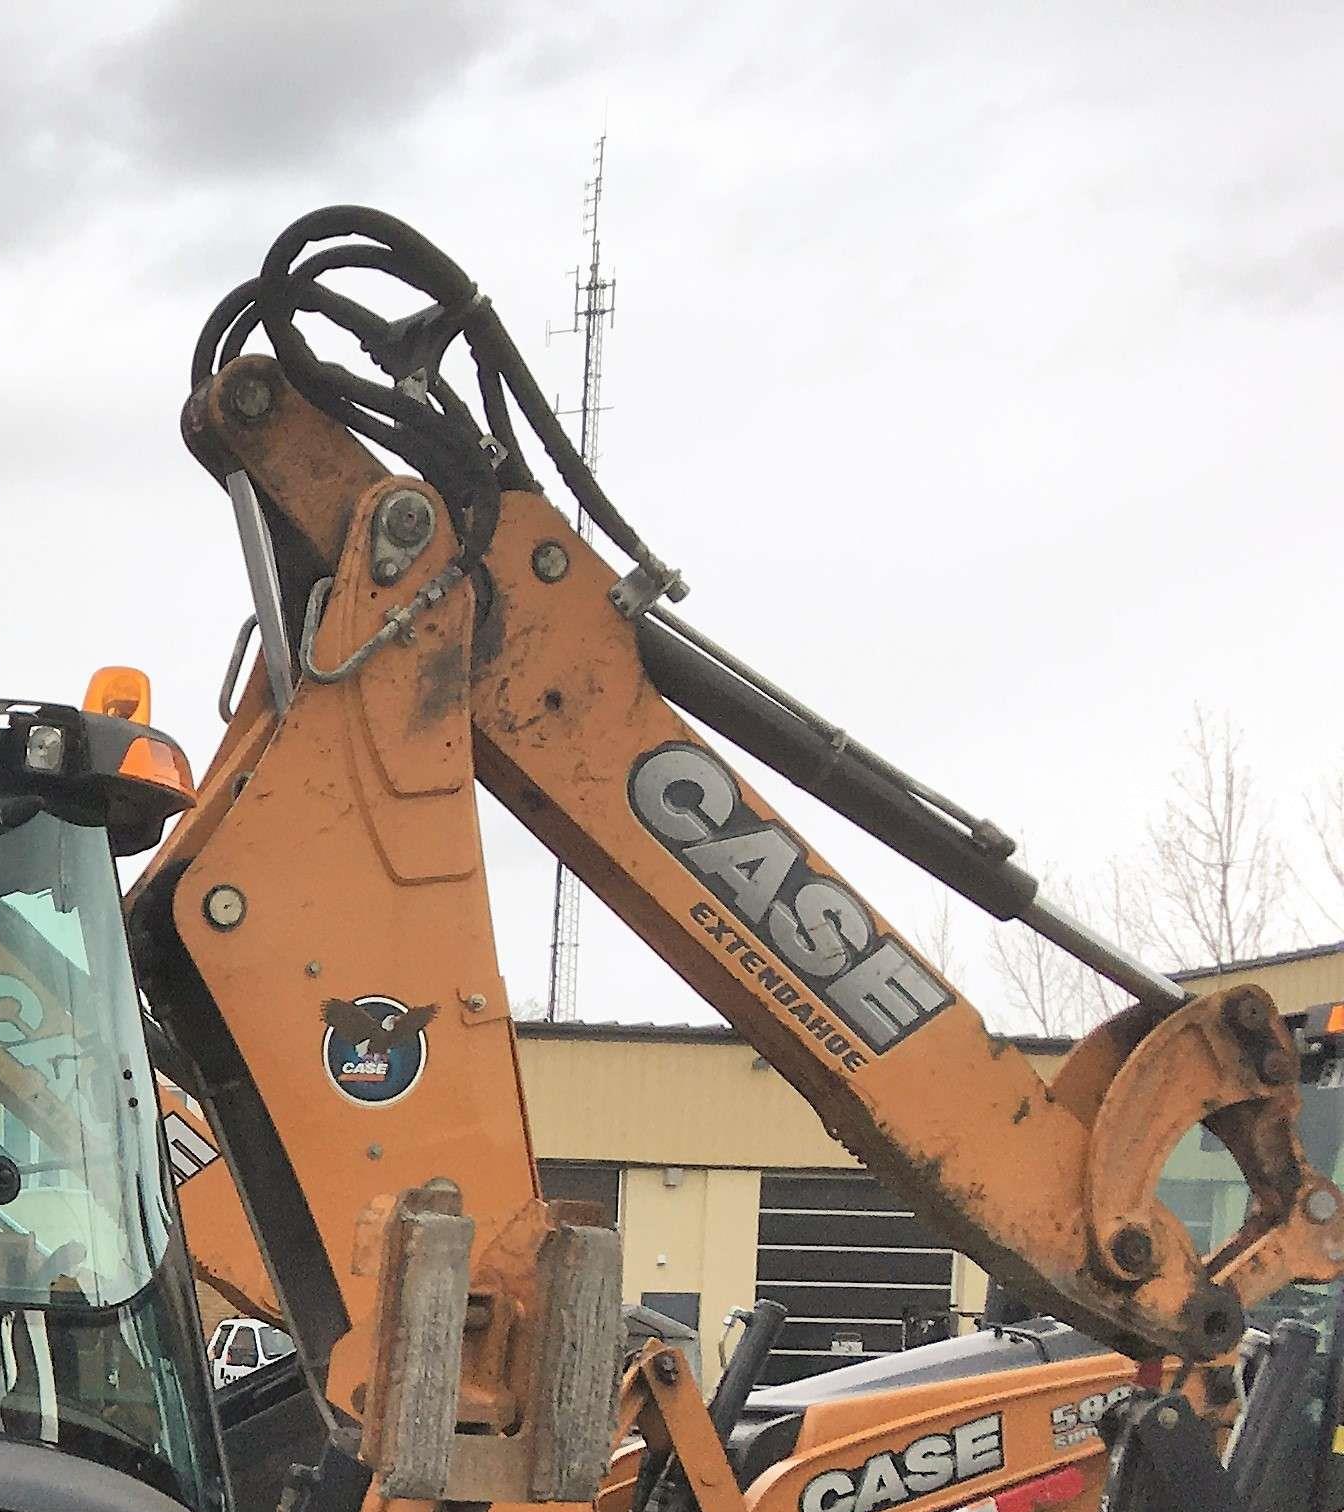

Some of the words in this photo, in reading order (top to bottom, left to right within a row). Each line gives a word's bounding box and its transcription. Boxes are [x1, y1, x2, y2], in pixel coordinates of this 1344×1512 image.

[626, 741, 957, 1056] CASE
[342, 1062, 389, 1075] CASE
[688, 901, 869, 1073] EXTENDAHOE
